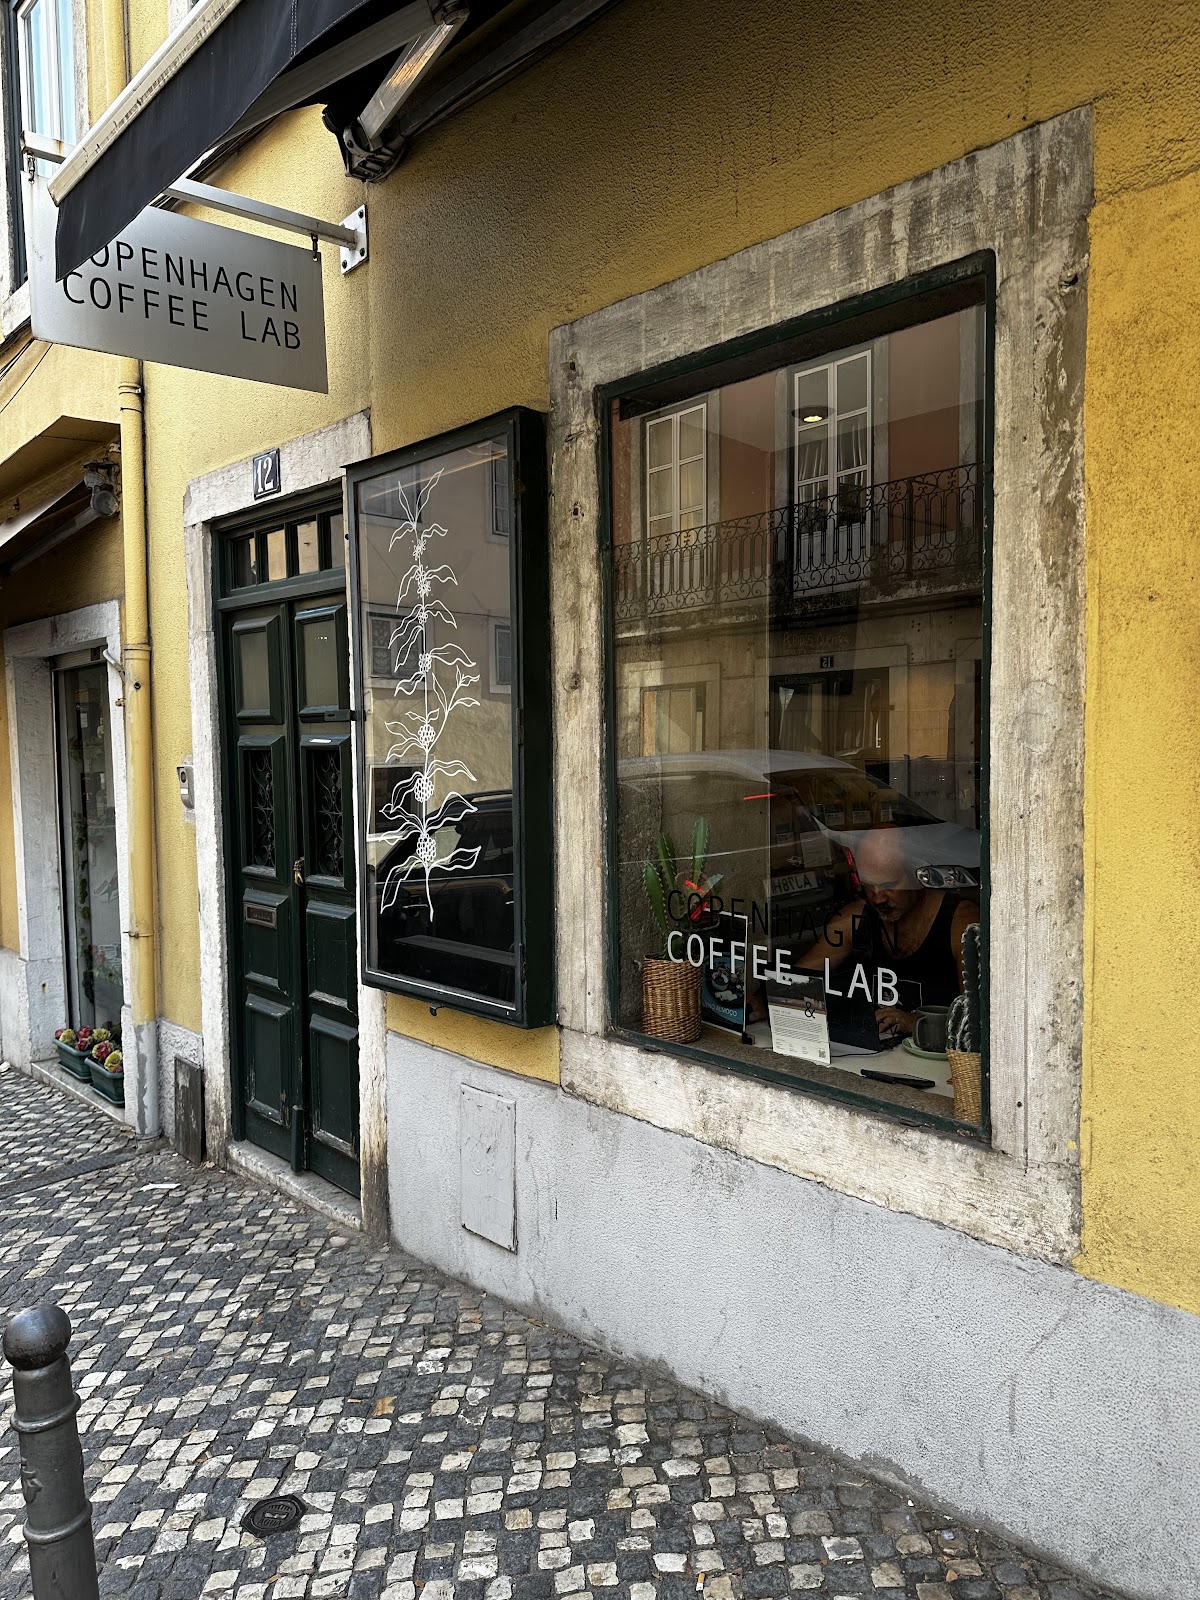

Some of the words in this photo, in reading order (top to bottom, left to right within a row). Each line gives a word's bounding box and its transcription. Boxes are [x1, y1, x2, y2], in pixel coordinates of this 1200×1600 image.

[62, 271, 210, 332] COFFEE
[240, 310, 301, 350] LAB
[89, 240, 298, 313] OPENHAGEN
[255, 456, 274, 494] 12
[667, 889, 898, 955] COPENHAGEN
[667, 930, 792, 986] COFFEE
[824, 957, 899, 1007] LAB
[804, 1001, 816, 1019] &
